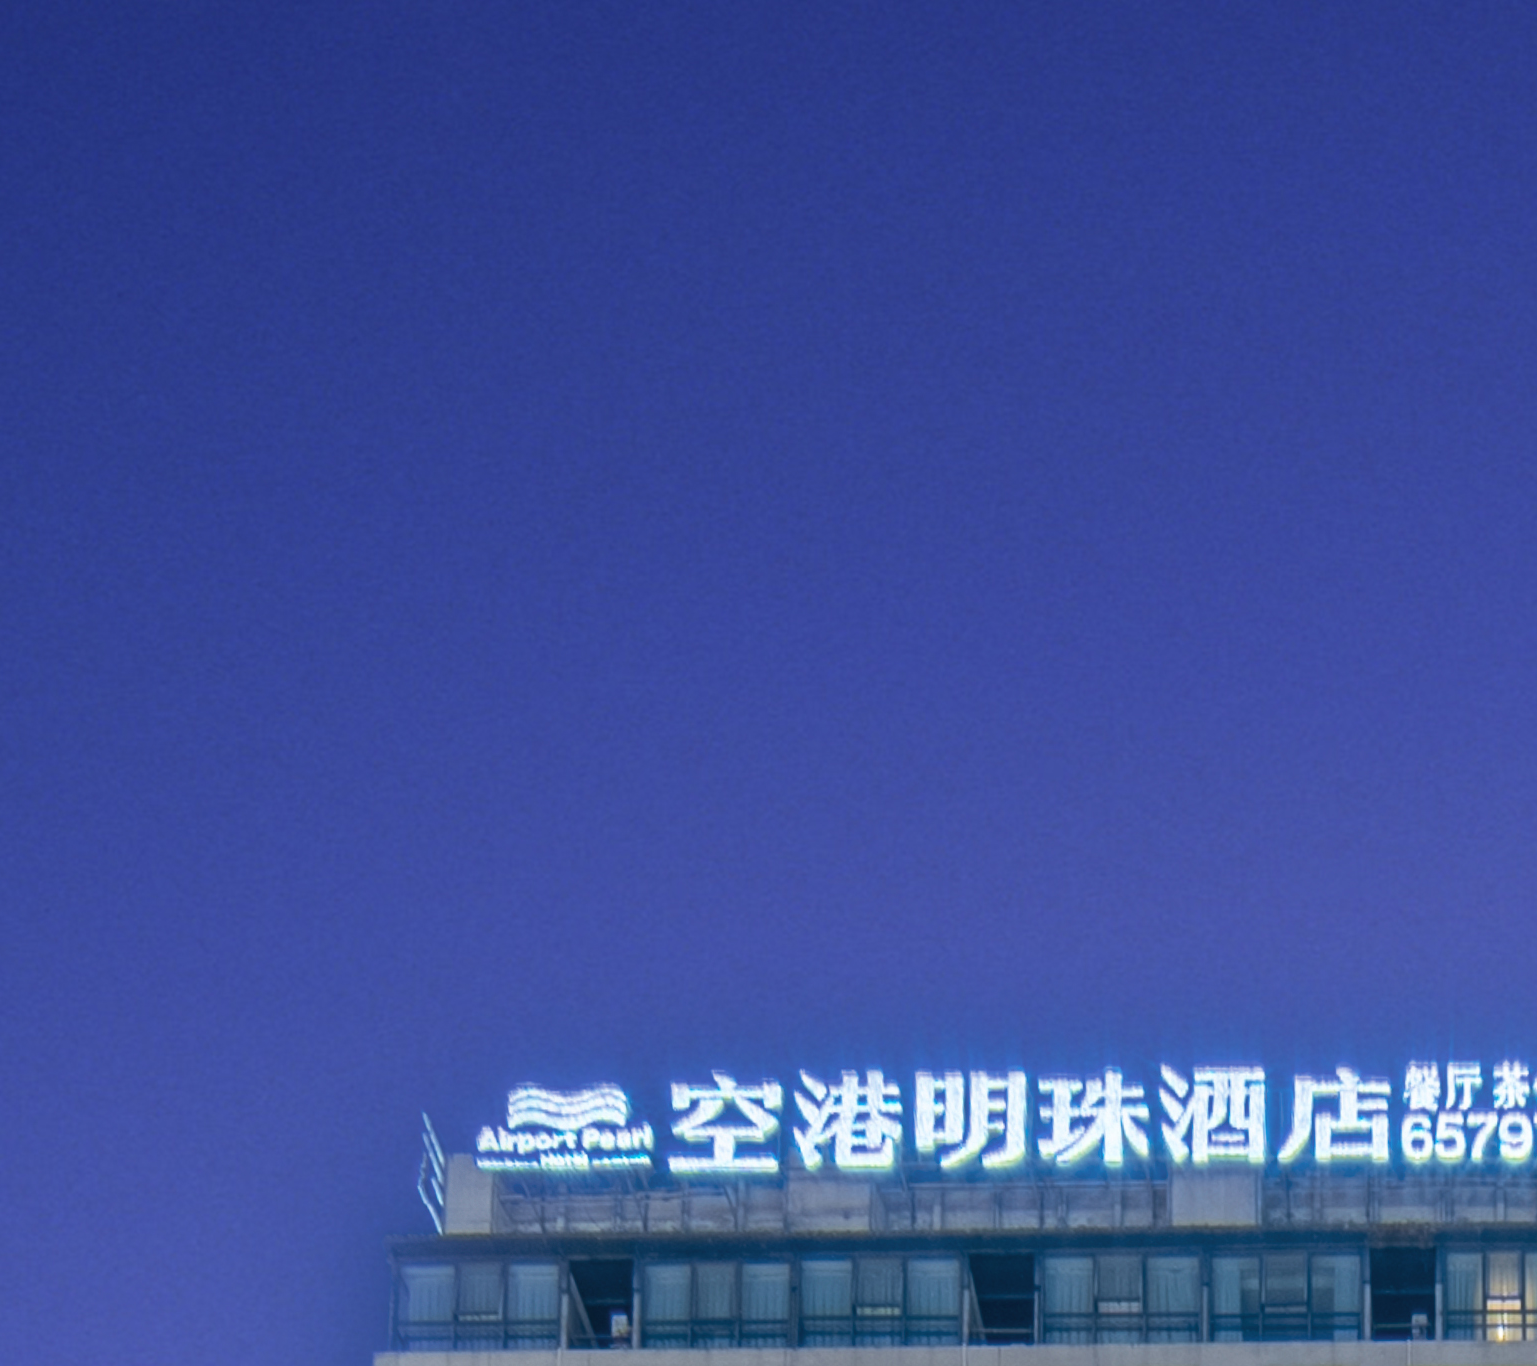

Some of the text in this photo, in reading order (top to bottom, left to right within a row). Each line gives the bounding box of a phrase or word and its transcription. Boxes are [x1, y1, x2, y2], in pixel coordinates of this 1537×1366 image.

[1404, 1061, 1482, 1109] 餐厅
[477, 1122, 653, 1156] Airport Pearl
[669, 1065, 1390, 1171] 空港明珠酒店
